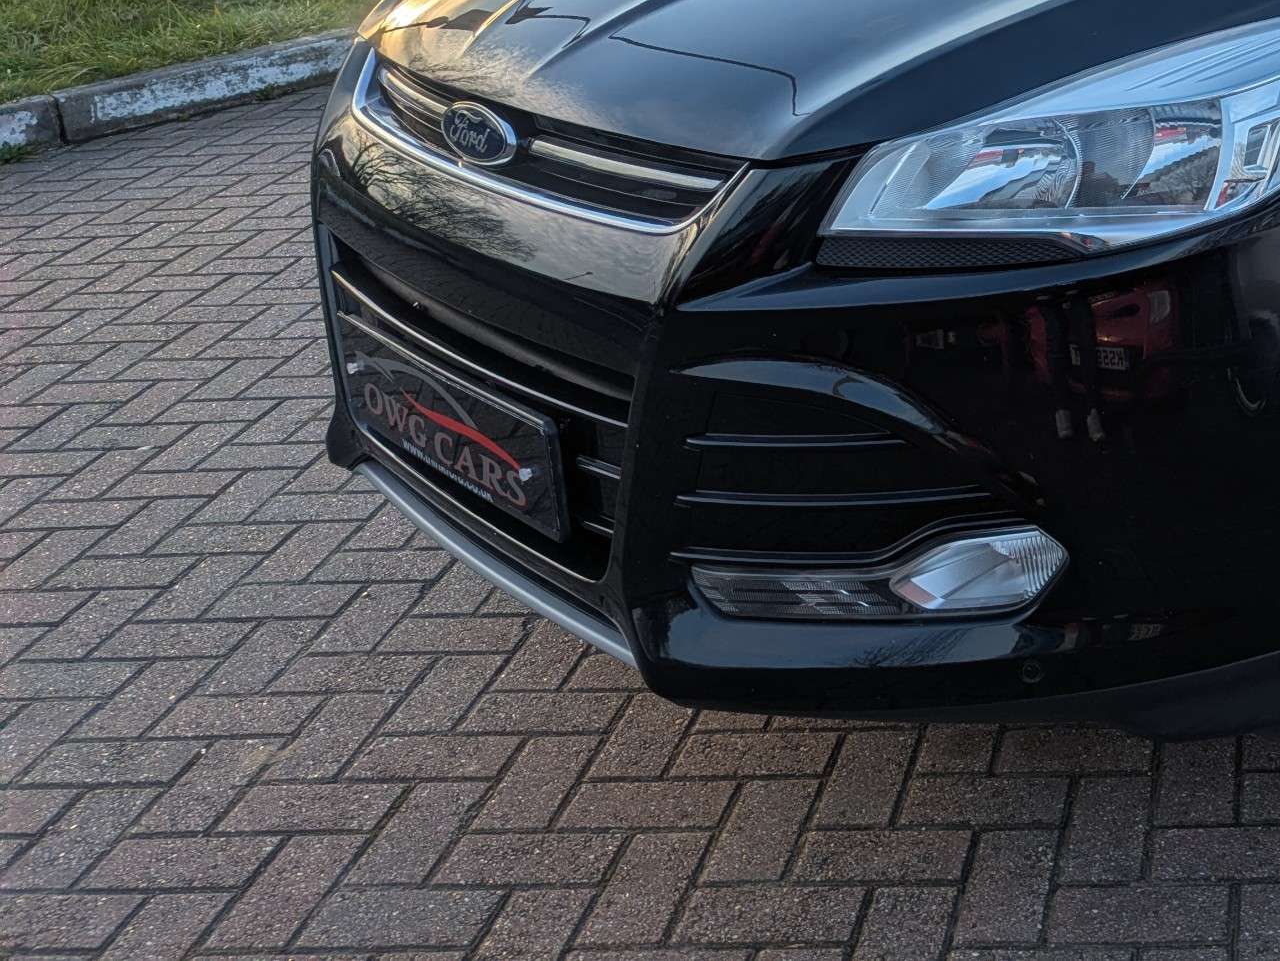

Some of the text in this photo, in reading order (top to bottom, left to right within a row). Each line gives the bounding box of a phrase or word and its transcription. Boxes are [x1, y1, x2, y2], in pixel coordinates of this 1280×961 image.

[449, 109, 490, 153] Ford
[363, 382, 426, 448] OWG
[434, 432, 530, 510] CARS
